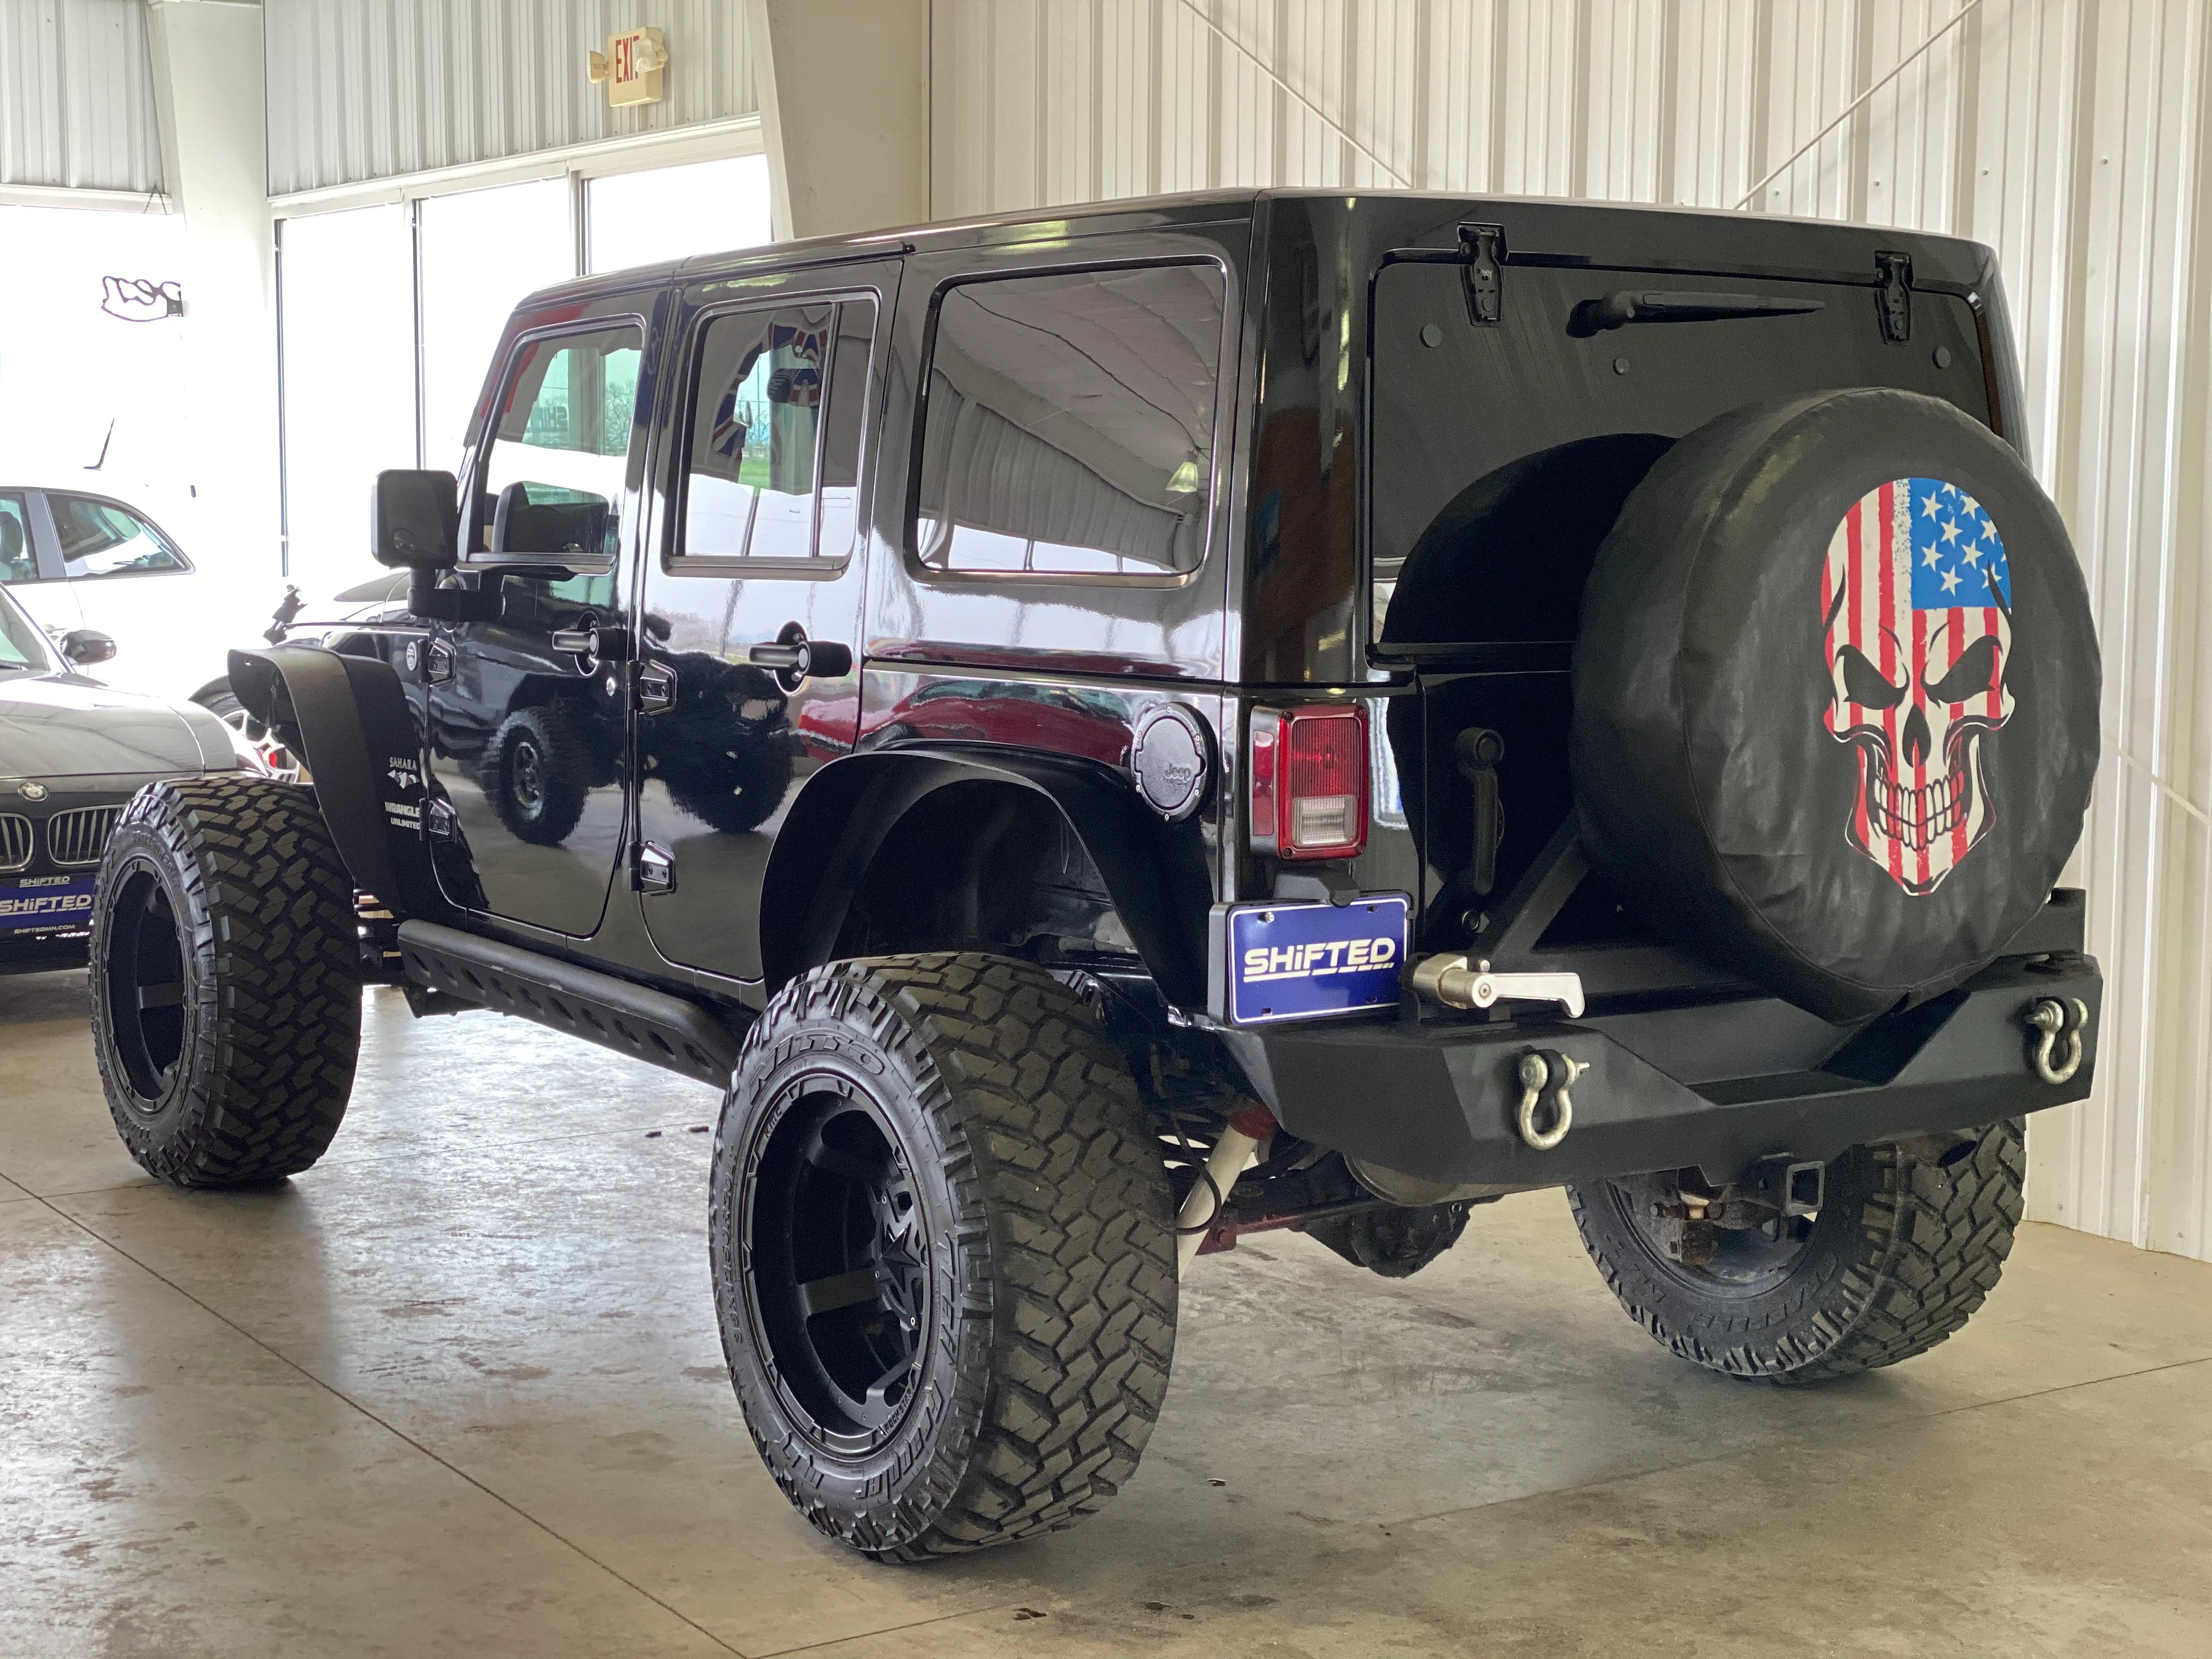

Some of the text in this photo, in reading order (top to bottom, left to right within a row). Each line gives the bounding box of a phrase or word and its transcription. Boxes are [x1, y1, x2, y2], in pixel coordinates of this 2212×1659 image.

[390, 757, 417, 770] SAHARA
[1165, 763, 1191, 783] Jeep
[385, 802, 420, 818] WRANGLE
[391, 817, 420, 830] UNLIMITED
[14, 924, 75, 934] SHIFTEDMN.COM
[749, 1029, 885, 1105] NITTO
[884, 1388, 912, 1434] ROCKSTAR
